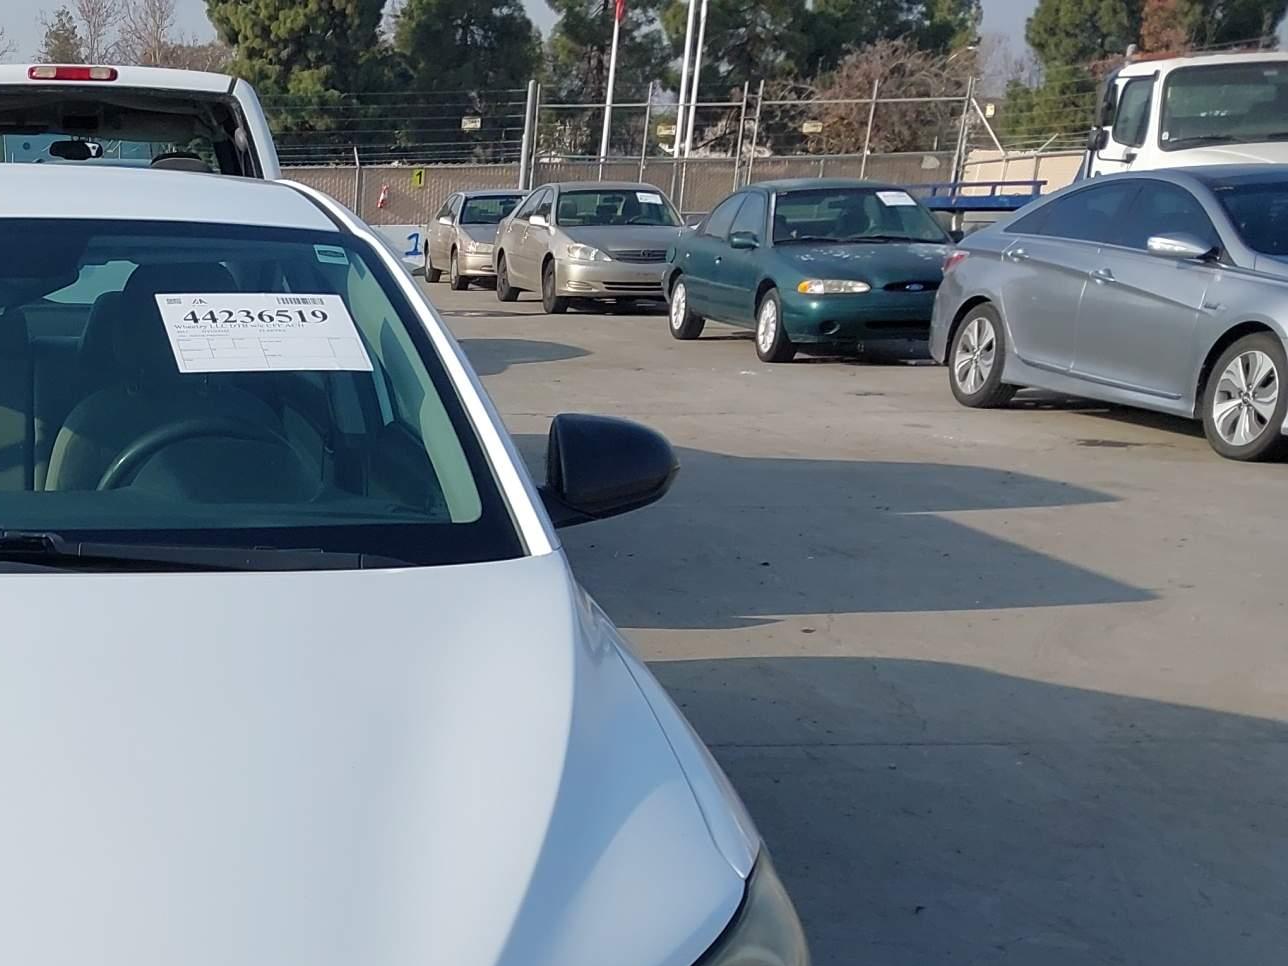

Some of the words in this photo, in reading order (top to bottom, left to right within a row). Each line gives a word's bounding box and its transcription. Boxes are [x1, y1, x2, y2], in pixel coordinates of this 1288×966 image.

[415, 170, 423, 185] 1
[405, 232, 423, 256] 1
[183, 310, 328, 324] 44236519
